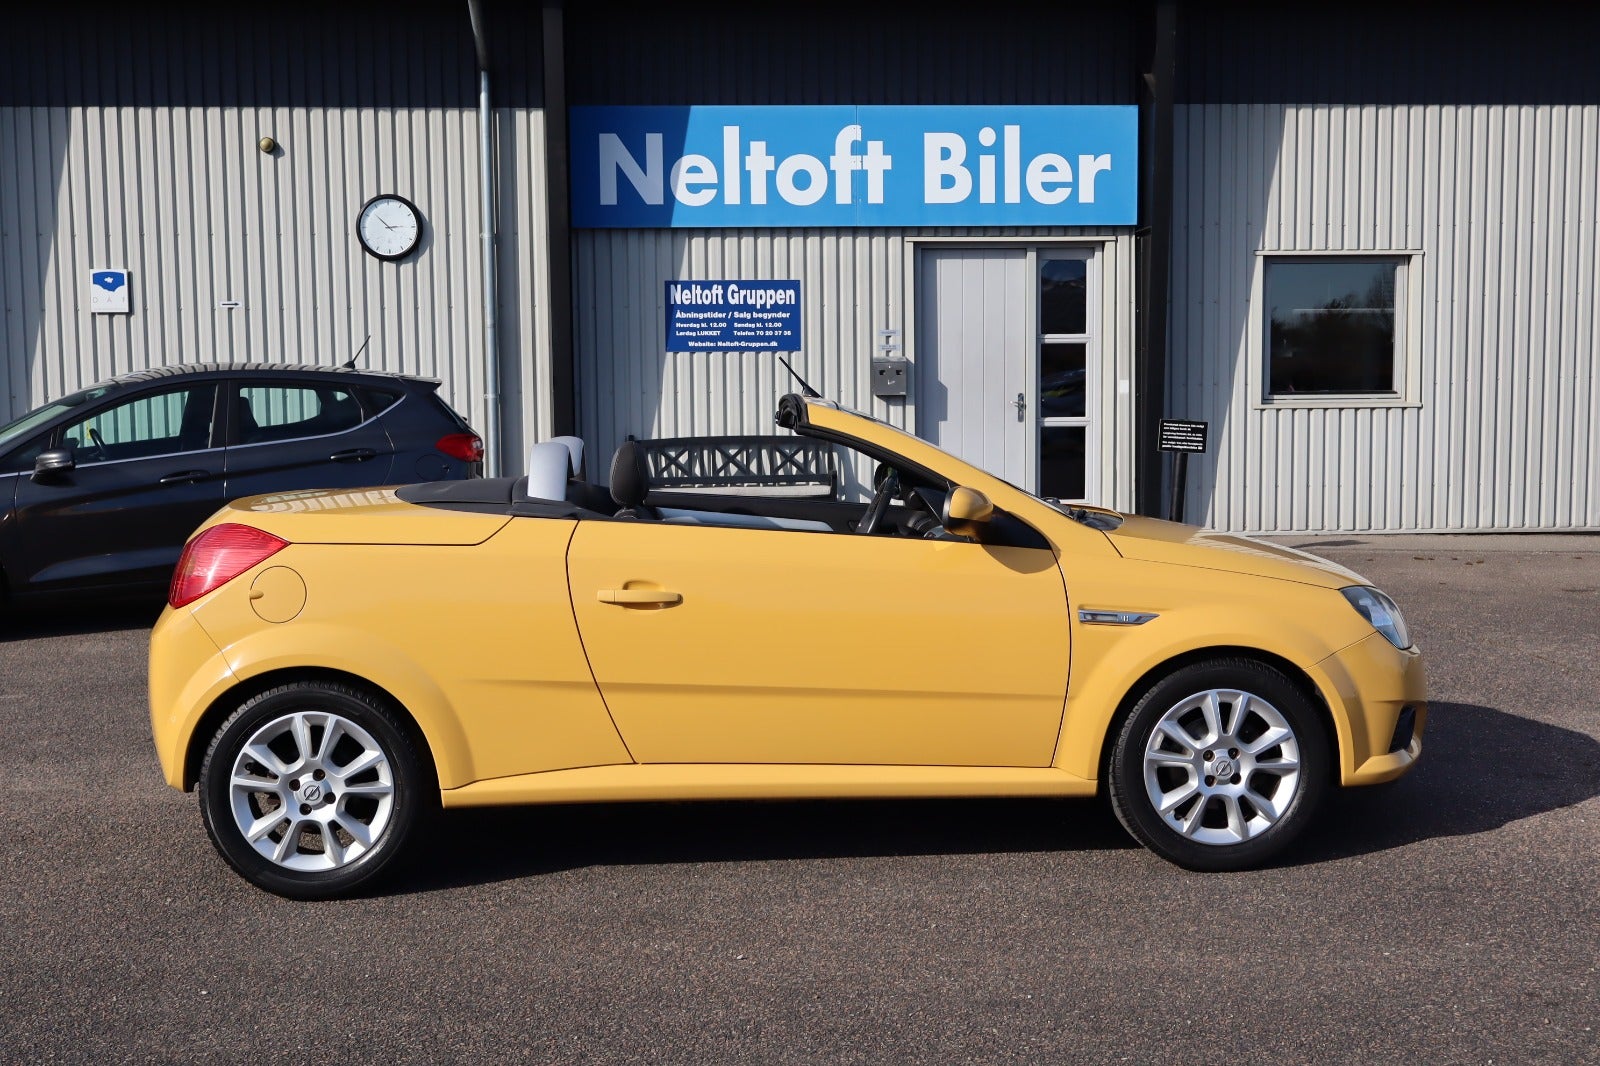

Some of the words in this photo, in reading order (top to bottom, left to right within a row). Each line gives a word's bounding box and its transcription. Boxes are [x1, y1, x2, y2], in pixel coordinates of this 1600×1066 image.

[599, 124, 892, 206] Neltoft
[923, 124, 1111, 204] Biler
[670, 284, 724, 305] Neltoft
[727, 284, 796, 309] Gruppen
[675, 310, 726, 319] Åbningstider
[733, 311, 752, 319] Salg
[752, 311, 790, 319] begynder
